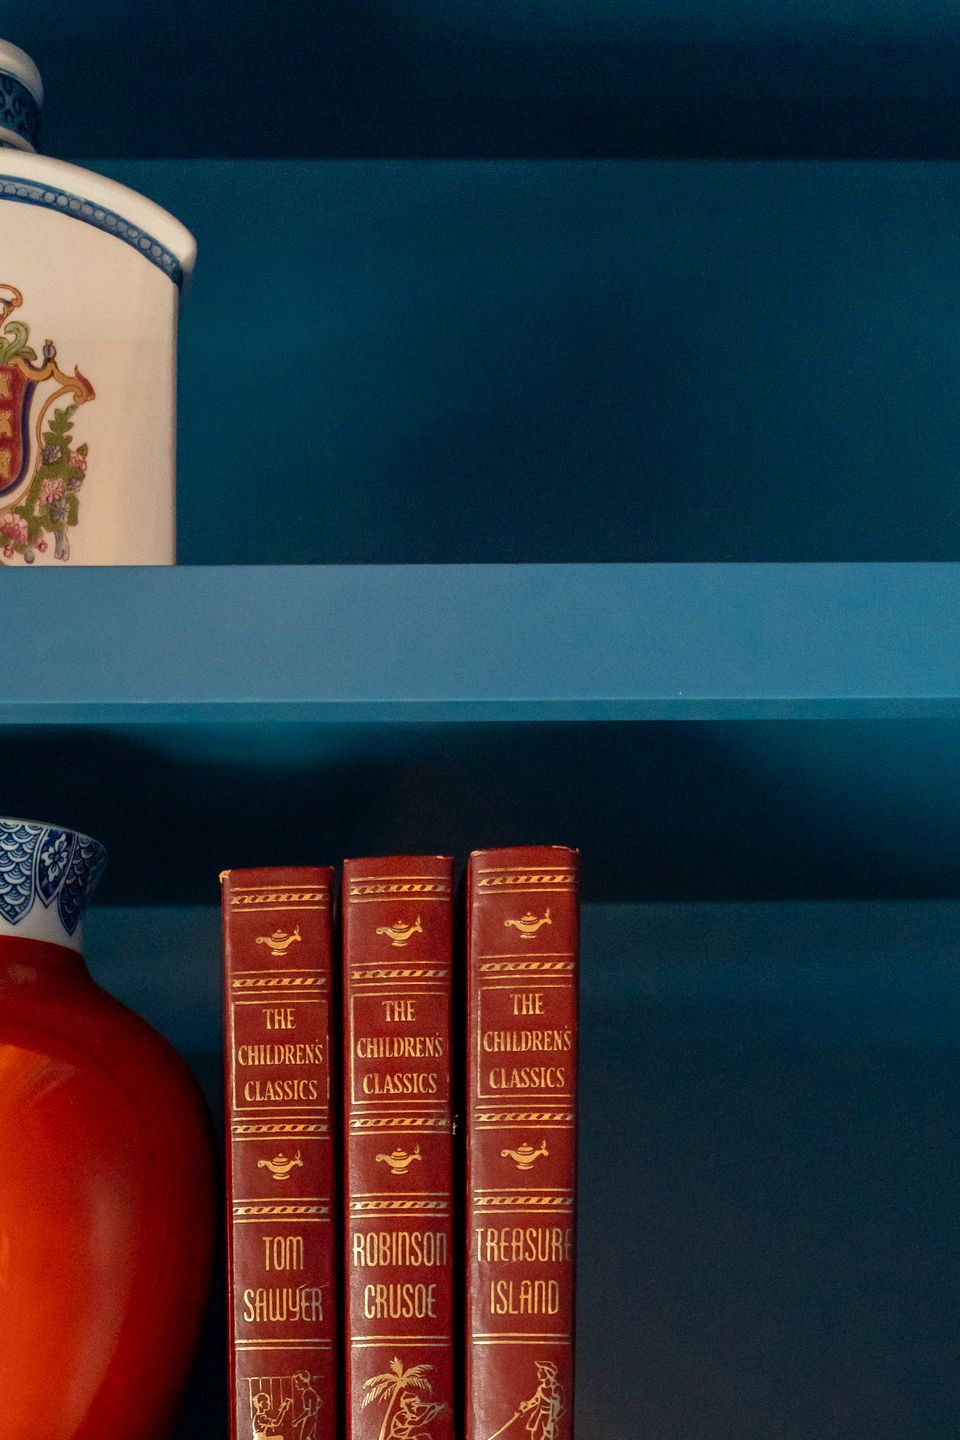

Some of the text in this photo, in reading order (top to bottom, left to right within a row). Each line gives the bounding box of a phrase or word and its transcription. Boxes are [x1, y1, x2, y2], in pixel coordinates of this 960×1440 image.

[382, 1001, 416, 1022] THE
[509, 993, 544, 1015] THE
[262, 1008, 295, 1030] THE
[244, 1080, 318, 1101] CLASSICS
[362, 1073, 437, 1094] CLASSICS
[489, 1067, 565, 1089] CLASSICS
[263, 1236, 304, 1271] TOM
[353, 1232, 448, 1267] ROBINSON
[476, 1229, 572, 1262] TREASURE
[243, 1286, 323, 1322] SAWYER
[364, 1284, 437, 1319] CRUSOE
[490, 1280, 559, 1315] ISLAND
